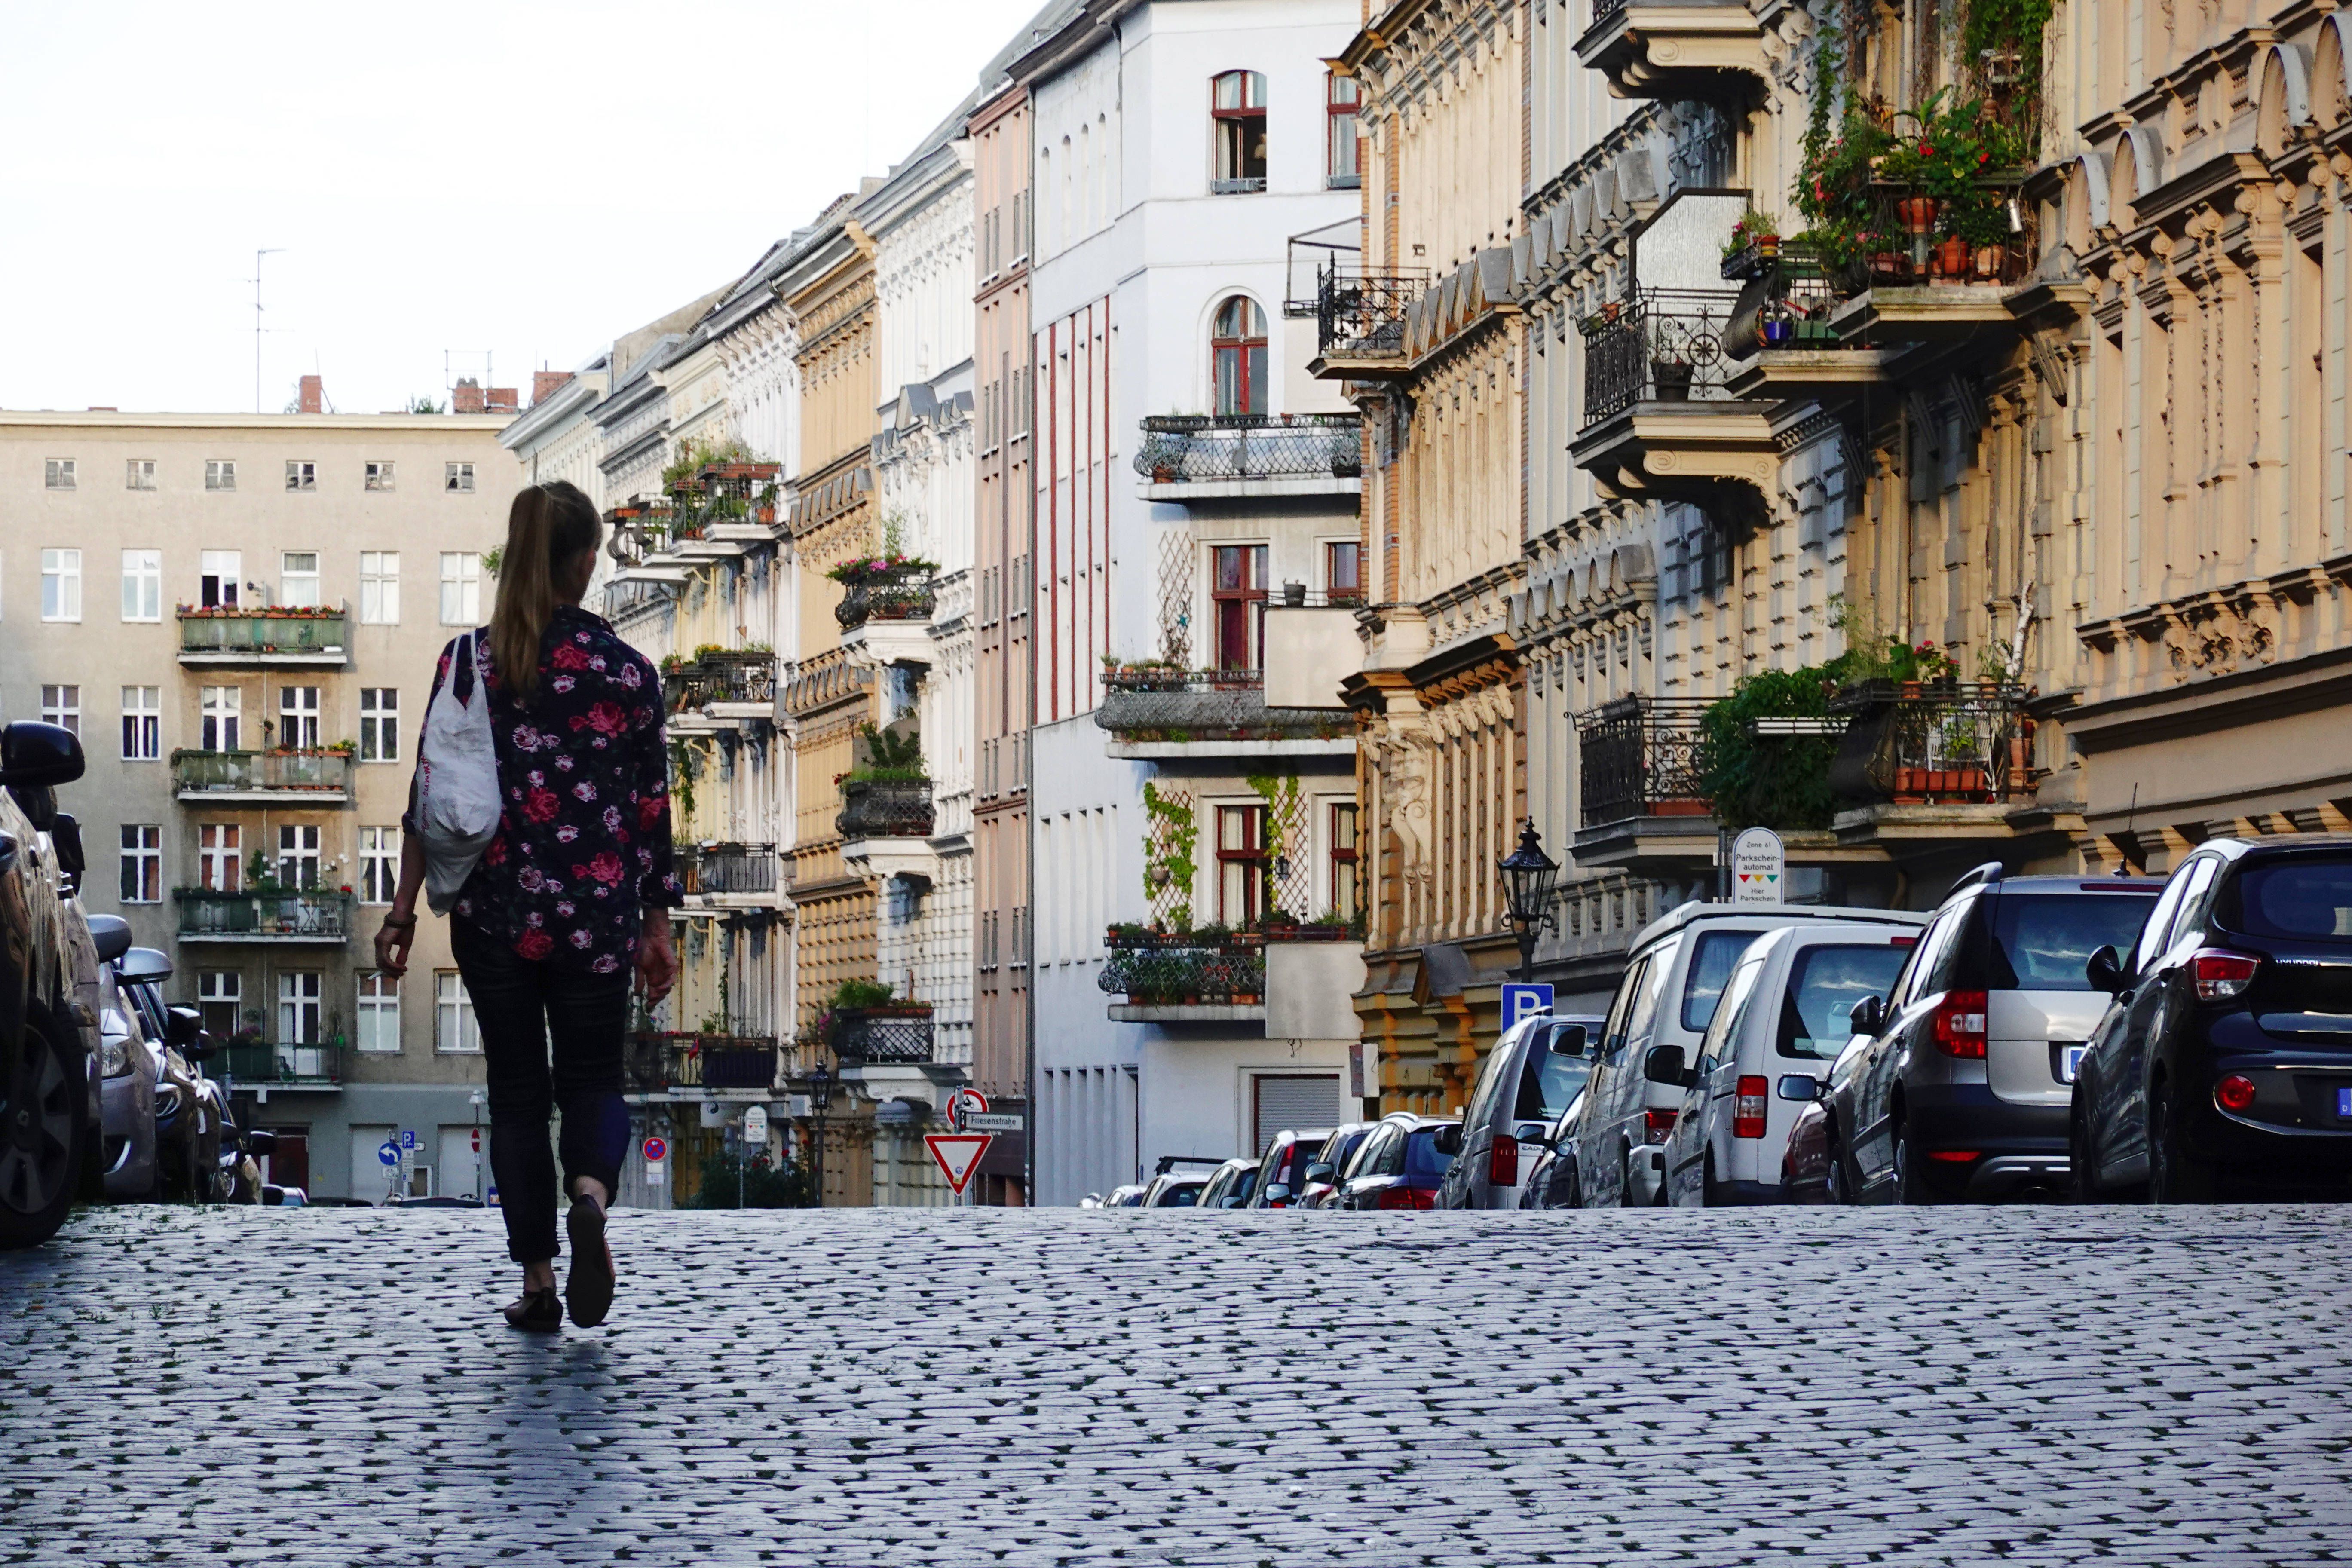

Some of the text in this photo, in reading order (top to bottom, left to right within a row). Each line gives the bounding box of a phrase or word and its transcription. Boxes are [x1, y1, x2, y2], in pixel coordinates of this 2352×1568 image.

[1514, 991, 1541, 1026] P
[971, 1115, 1016, 1127] Friesenstraße
[404, 1133, 411, 1147] P
